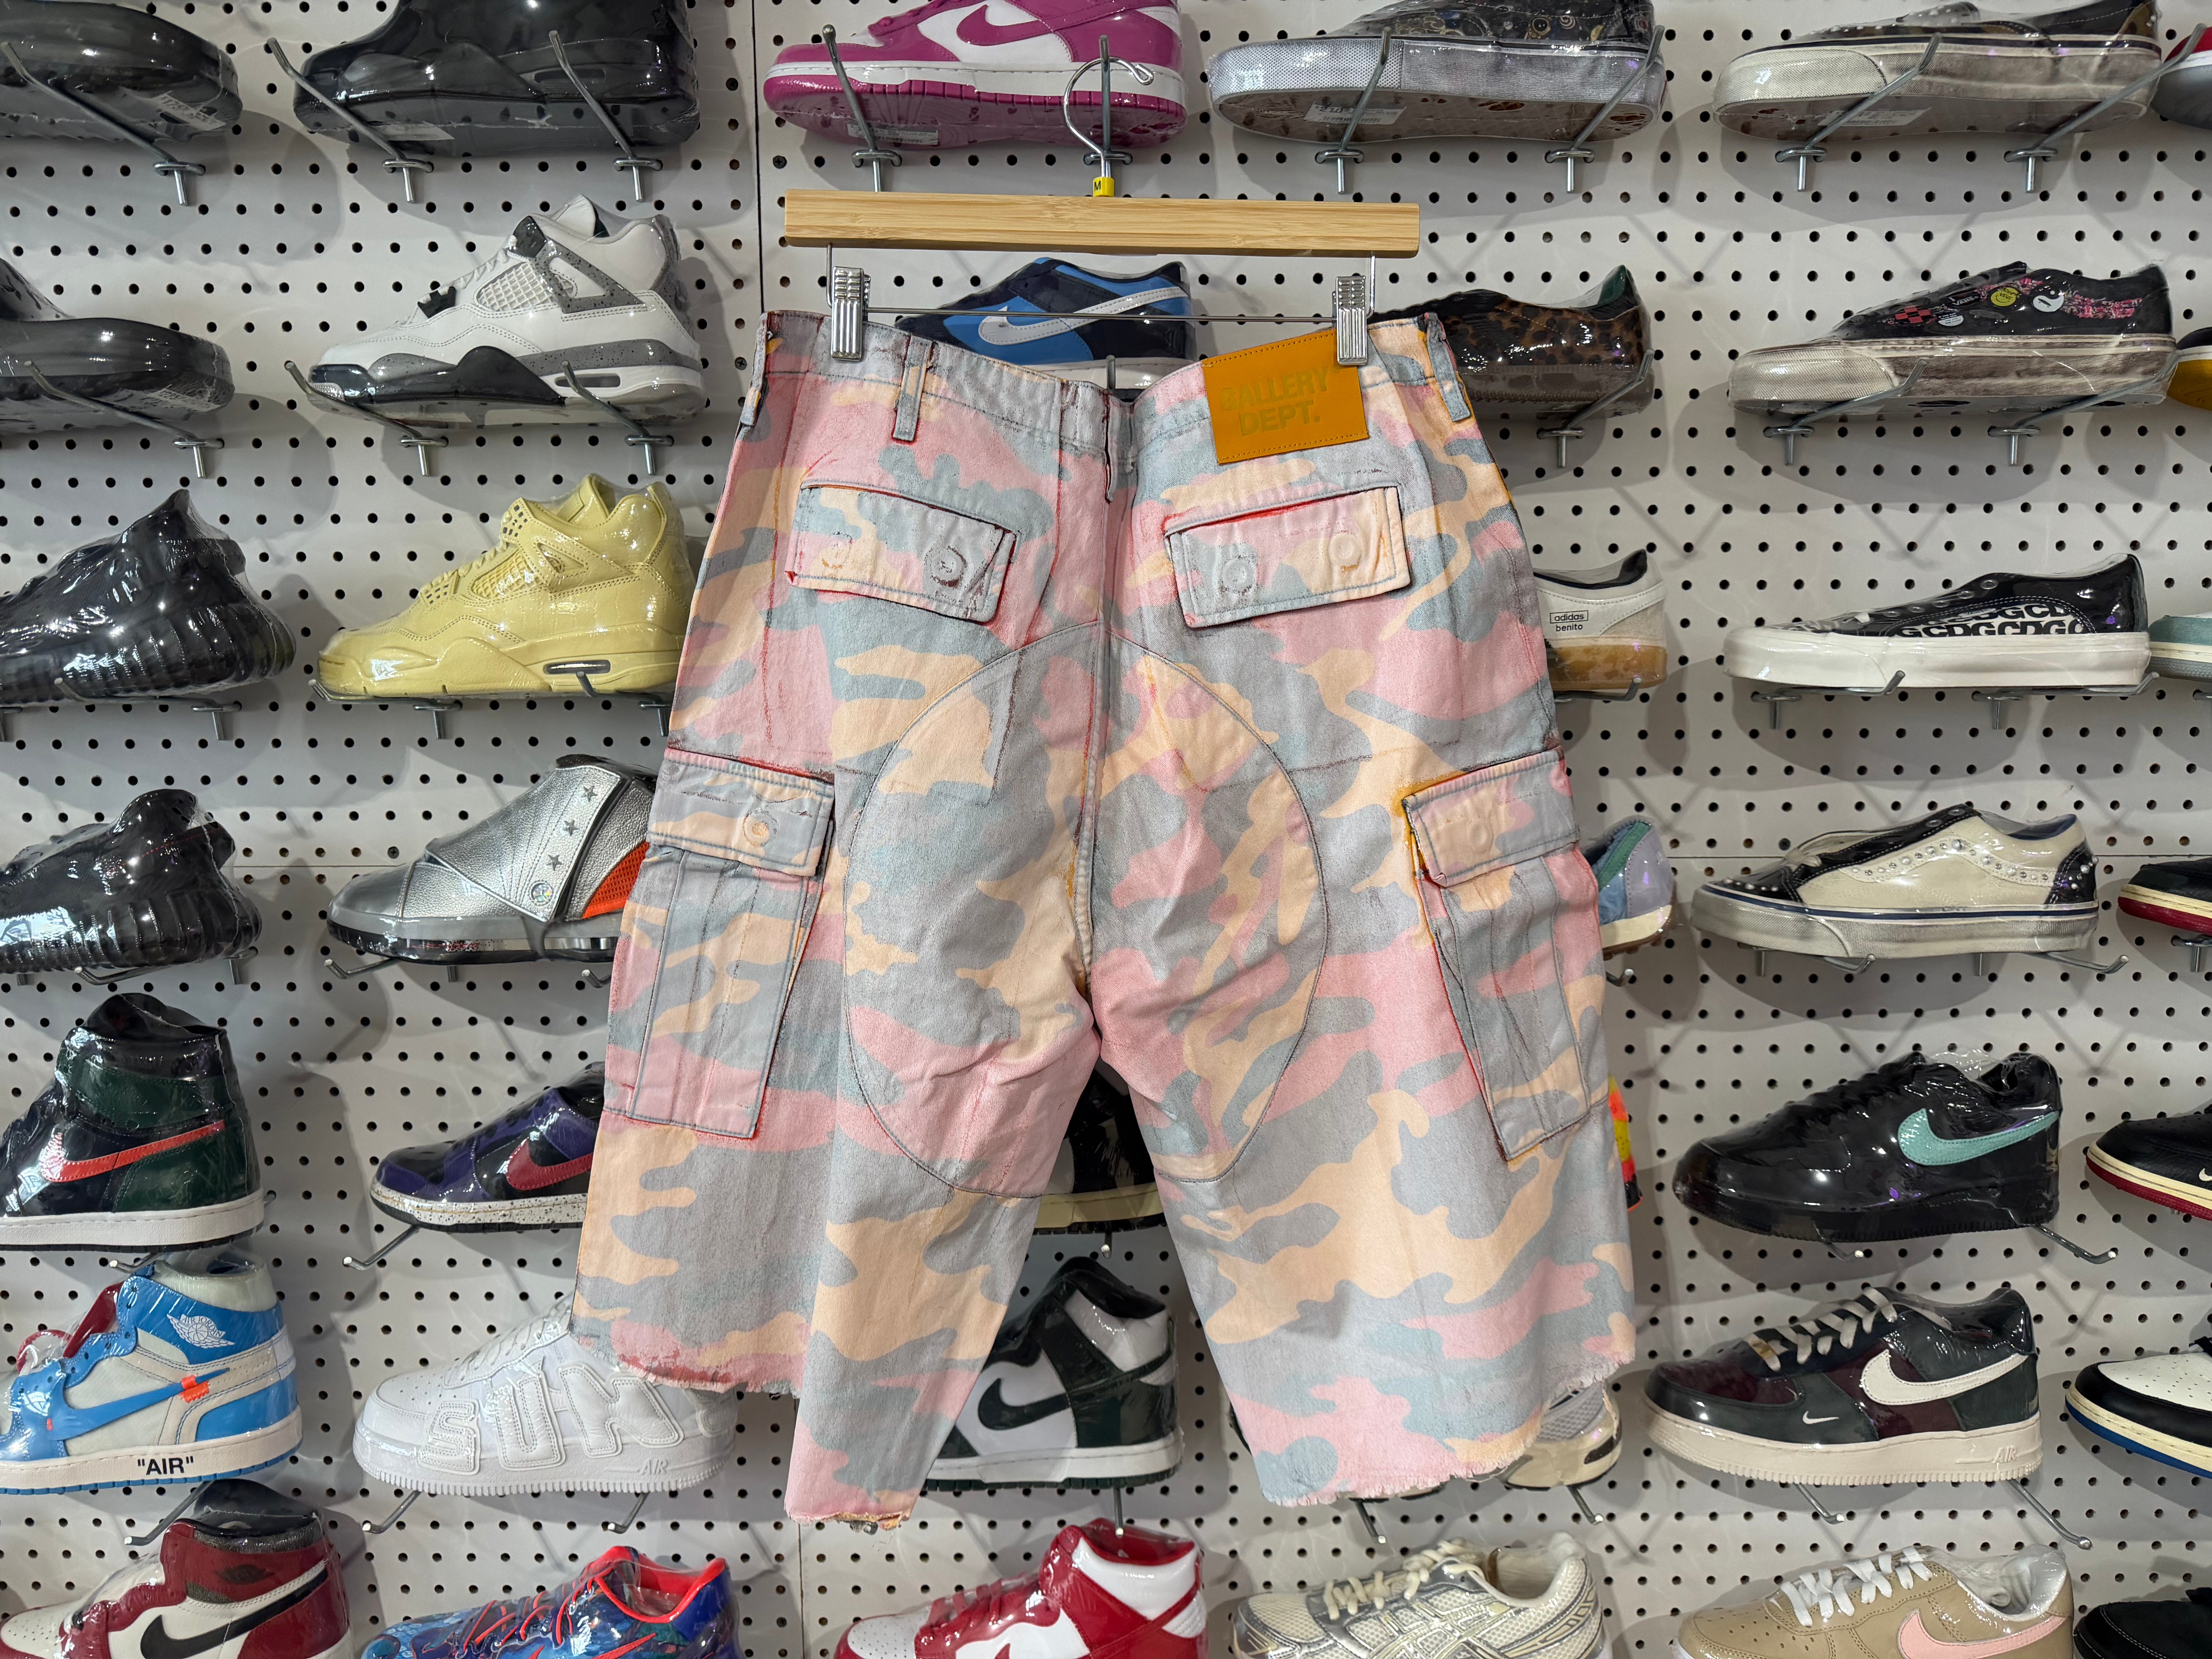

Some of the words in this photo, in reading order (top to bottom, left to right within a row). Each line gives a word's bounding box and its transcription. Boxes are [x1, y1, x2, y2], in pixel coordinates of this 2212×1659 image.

[1094, 180, 1101, 191] M
[1219, 365, 1329, 411] GALLERY
[1240, 400, 1320, 436] DEPT.
[1556, 623, 1583, 632] benito
[182, 1316, 196, 1324] AIR
[198, 1316, 222, 1337] JORDAN
[1993, 1445, 2016, 1463] AIR
[137, 1456, 194, 1475] "AIR"
[639, 1459, 668, 1474] AIR
